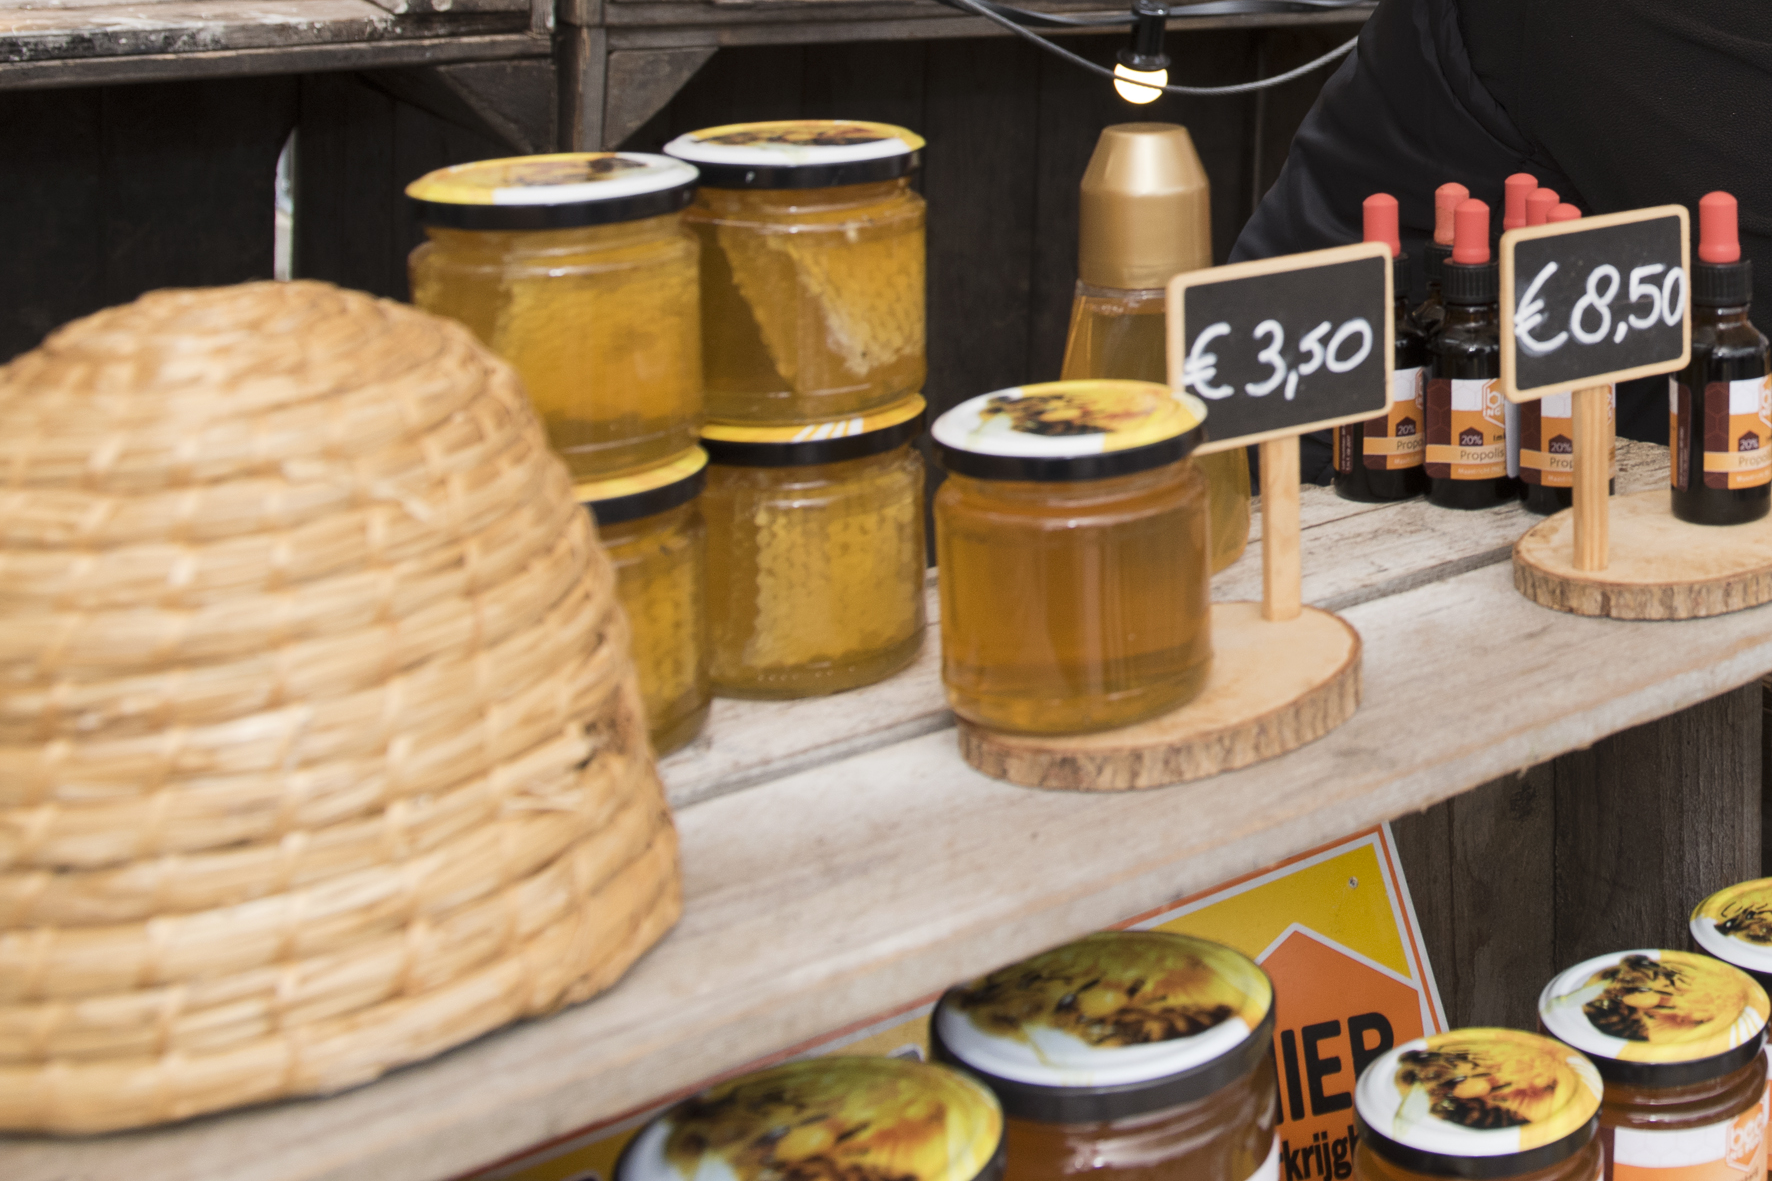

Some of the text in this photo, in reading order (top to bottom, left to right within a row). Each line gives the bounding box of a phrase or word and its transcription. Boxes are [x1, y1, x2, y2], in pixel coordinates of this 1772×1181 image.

[1461, 434, 1483, 446] 20%
[1550, 441, 1573, 453] 20%
[1460, 447, 1505, 462] Propolis
